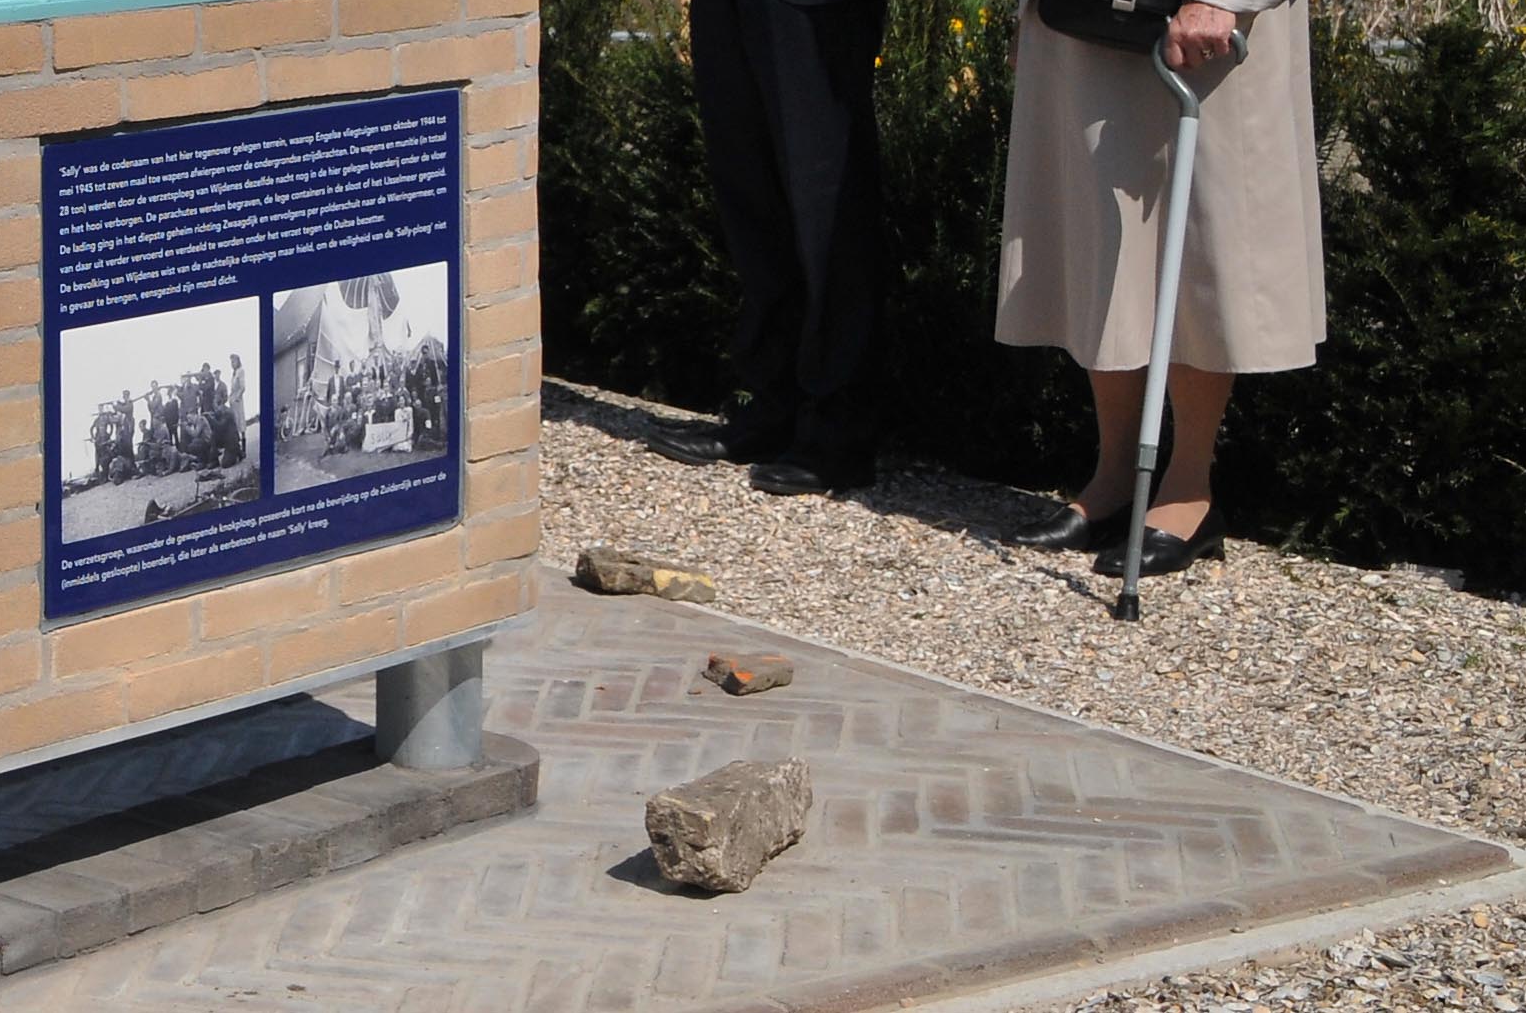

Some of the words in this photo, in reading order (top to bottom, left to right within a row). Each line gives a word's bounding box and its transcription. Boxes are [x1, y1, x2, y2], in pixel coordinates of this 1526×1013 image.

[59, 185, 73, 196] mei
[75, 182, 93, 194] 1945
[94, 182, 106, 191] tot
[107, 180, 129, 190] zeven
[129, 174, 147, 186] maal
[148, 175, 160, 184] toe
[161, 171, 189, 183] wapens
[226, 163, 242, 172] voor
[253, 153, 301, 168] ondergrondse
[360, 143, 385, 154] wapens
[394, 136, 418, 147] munitie
[82, 165, 98, 173] was
[111, 158, 149, 170] codenaam
[150, 156, 164, 164] van
[165, 152, 177, 162] het
[179, 150, 193, 160] hier
[194, 146, 231, 160] tegenover
[232, 141, 261, 155] gelegen
[288, 135, 314, 145] waarop
[315, 129, 341, 143] Engelse
[392, 118, 418, 130] oktober
[70, 202, 86, 214] ton)
[87, 199, 116, 211] werden
[117, 197, 135, 207] door
[148, 188, 194, 202] verzetsploeg
[195, 187, 208, 195] van
[209, 181, 242, 195] Wijdenes
[243, 175, 274, 189] dezelfde
[275, 172, 294, 184] nacht
[295, 172, 309, 182] nog
[327, 166, 341, 175] hier
[342, 162, 369, 176] gelegen
[369, 156, 399, 169] boerderij
[400, 154, 420, 165] onder
[430, 150, 446, 160] vloer
[70, 223, 84, 233] het
[85, 219, 102, 231] hooi
[158, 207, 197, 223] parachutes
[198, 201, 226, 214] werden
[274, 192, 289, 204] lege
[290, 187, 325, 200] containers
[344, 181, 361, 191] sloot
[59, 265, 73, 274] van
[74, 261, 92, 272] daar
[93, 258, 104, 268] uit
[105, 254, 129, 266] verder
[130, 247, 163, 262] vervoerd
[175, 240, 207, 255] verdeeld
[217, 236, 244, 248] worden
[245, 232, 266, 244] onder
[267, 230, 279, 240] het
[280, 227, 301, 238] verzet
[302, 224, 322, 236] tegen
[333, 218, 355, 229] Duitse
[72, 241, 96, 253] lading
[97, 238, 114, 251] ging
[124, 234, 136, 244] het
[137, 231, 165, 243] diepste
[166, 225, 193, 240] geheim
[194, 221, 221, 233] richting
[269, 209, 306, 221] vervolgens
[306, 207, 318, 218] per
[319, 198, 360, 216] polderschuit
[361, 197, 376, 206] naar
[72, 277, 109, 291] bevolking
[110, 276, 124, 284] van
[125, 270, 159, 283] Wijdenes
[160, 266, 175, 276] wist
[176, 265, 189, 273] van
[202, 255, 240, 269] nachtelijke
[241, 250, 276, 264] droppings
[277, 247, 294, 256] maar
[338, 231, 370, 247] veiligheid
[434, 220, 446, 230] niet
[68, 300, 94, 314] gevaar
[182, 281, 194, 293] zijn
[195, 276, 217, 289] mond
[73, 549, 124, 566] verzetsgroep,
[126, 538, 164, 554] waaronder
[176, 525, 218, 545] gewapende
[218, 517, 257, 532] knokploeg,
[291, 505, 305, 515] kort
[325, 492, 359, 507] bevrijding
[422, 474, 436, 484] voor
[61, 571, 99, 590] (inmiddels
[101, 561, 140, 582] gesloopte)
[177, 550, 189, 561] die
[190, 547, 207, 557] later
[208, 542, 218, 554] als
[219, 535, 256, 551] eerbetoon
[267, 528, 286, 538] naam
